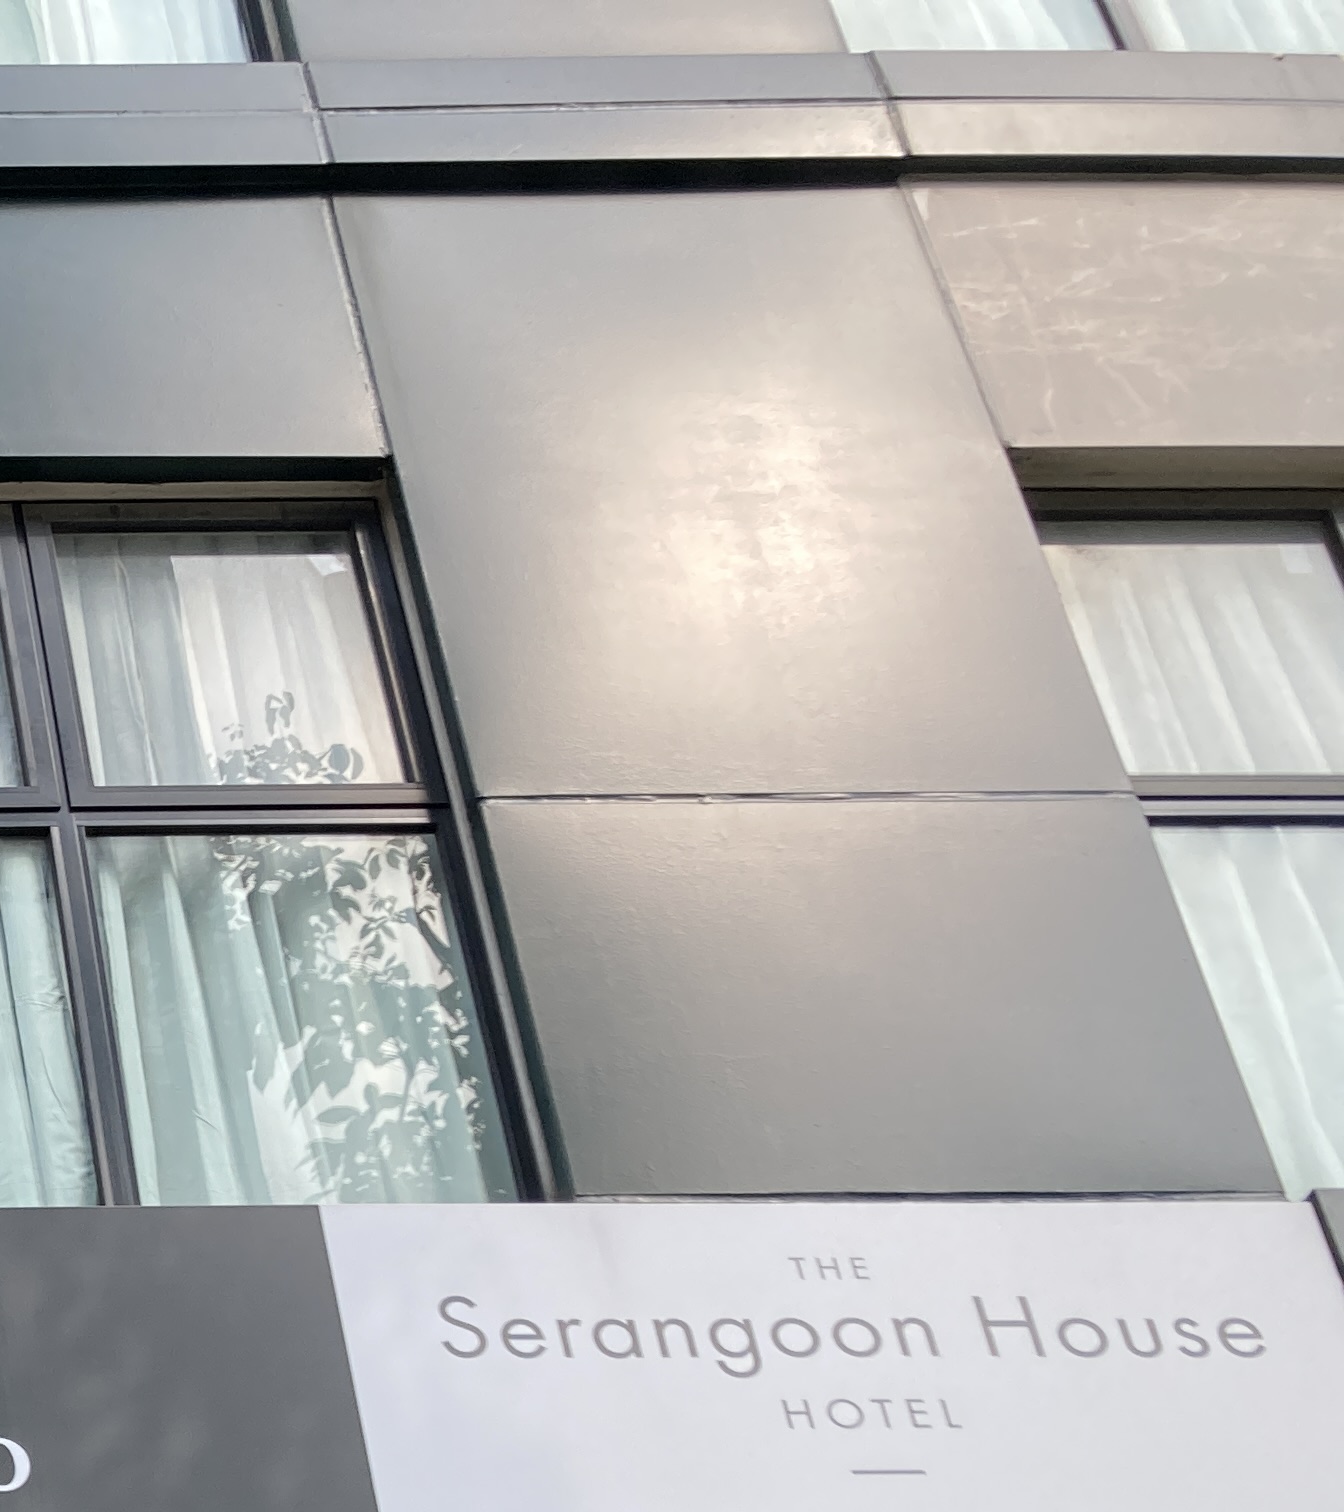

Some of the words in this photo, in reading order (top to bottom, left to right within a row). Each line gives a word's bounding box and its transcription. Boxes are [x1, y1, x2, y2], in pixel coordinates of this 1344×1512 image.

[788, 1256, 870, 1282] THE
[437, 1294, 942, 1379] Serangoon
[970, 1294, 1268, 1360] House
[780, 1398, 964, 1431] HOTEL
